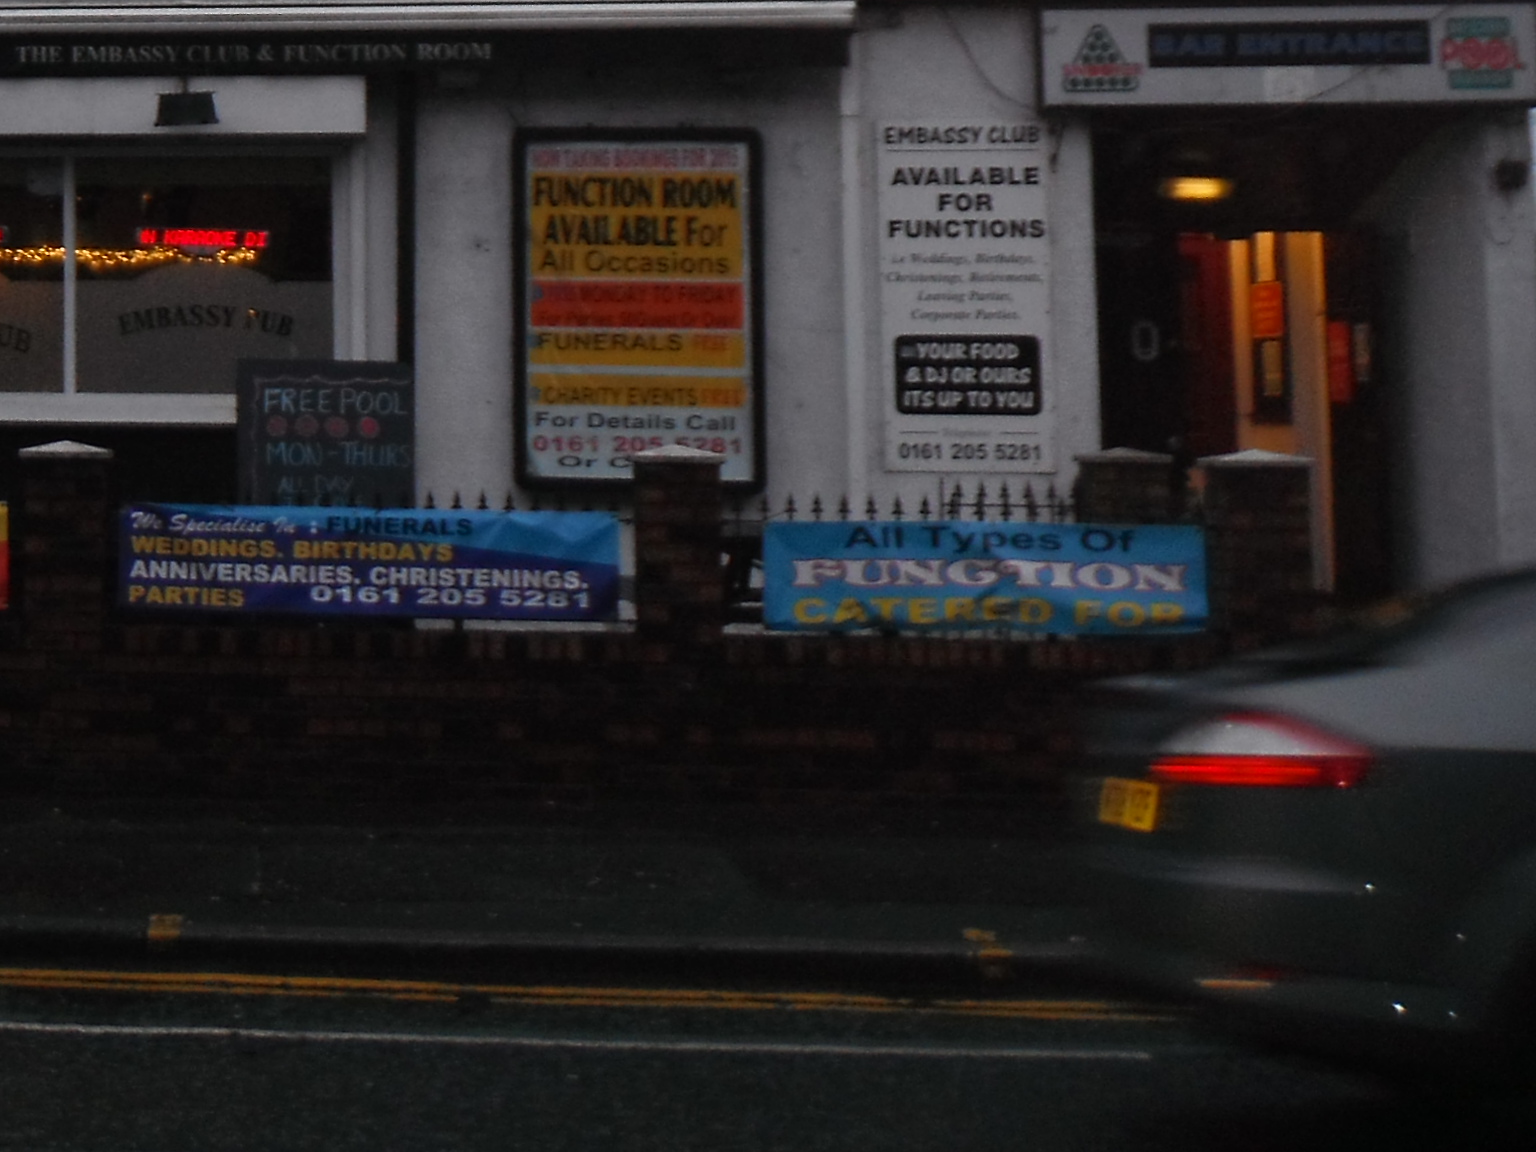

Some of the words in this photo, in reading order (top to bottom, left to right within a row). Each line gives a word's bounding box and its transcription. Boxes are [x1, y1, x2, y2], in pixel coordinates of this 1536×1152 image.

[16, 45, 64, 65] THE
[71, 45, 180, 65] EMBASSY
[186, 45, 251, 64] CLUB
[256, 45, 274, 63] &
[283, 43, 408, 64] FUNCTION
[417, 42, 493, 62] ROOM
[884, 126, 983, 145] EMBASSY
[987, 126, 1041, 145] CLUB
[891, 167, 1040, 186] AVAILABLE
[533, 175, 652, 208] FUNCTION
[661, 176, 737, 210] ROOM
[938, 194, 993, 212] FOR
[543, 214, 678, 247] AVAILABLE
[686, 216, 728, 247] For
[888, 219, 1045, 239] FUNCTIONS
[540, 250, 575, 273] All
[584, 250, 731, 274] Occasions
[117, 304, 237, 336] EMBASSY
[539, 332, 684, 352] FUNERALS
[916, 342, 968, 360] YOUR
[970, 342, 1020, 360] FOOD
[904, 365, 923, 383] &
[925, 365, 948, 384] DJ
[950, 365, 977, 384] OR
[979, 365, 1032, 385] OURS
[264, 387, 334, 414] FREE
[340, 387, 409, 415] POOL
[544, 385, 626, 405] CHARITY
[629, 386, 699, 406] EVENTS
[936, 389, 964, 408] UP
[965, 390, 993, 408] TO
[995, 390, 1035, 409] YOU
[534, 410, 580, 428] For
[588, 411, 676, 431] Details
[685, 412, 736, 431] Call
[266, 442, 323, 467] MON
[339, 441, 411, 468] THURS
[532, 434, 600, 452] 0161
[613, 435, 663, 453] 205
[899, 442, 942, 460] 0161
[951, 442, 988, 460] 205
[994, 443, 1041, 461] 5281
[557, 455, 598, 469] Or
[131, 510, 160, 532] We
[168, 512, 266, 536] Specialise
[275, 516, 297, 535] In
[326, 515, 474, 537] FUNERALS
[843, 526, 903, 549] All
[921, 526, 1061, 553] Types
[1080, 529, 1136, 552] Of
[293, 540, 454, 563] BIRTHDAYS
[792, 558, 1188, 592] FUNCTION
[128, 585, 246, 608] PARTIES
[309, 583, 402, 604] 0161
[415, 585, 487, 606] 205
[497, 586, 591, 608] 5281
[792, 596, 1055, 625] CATERED
